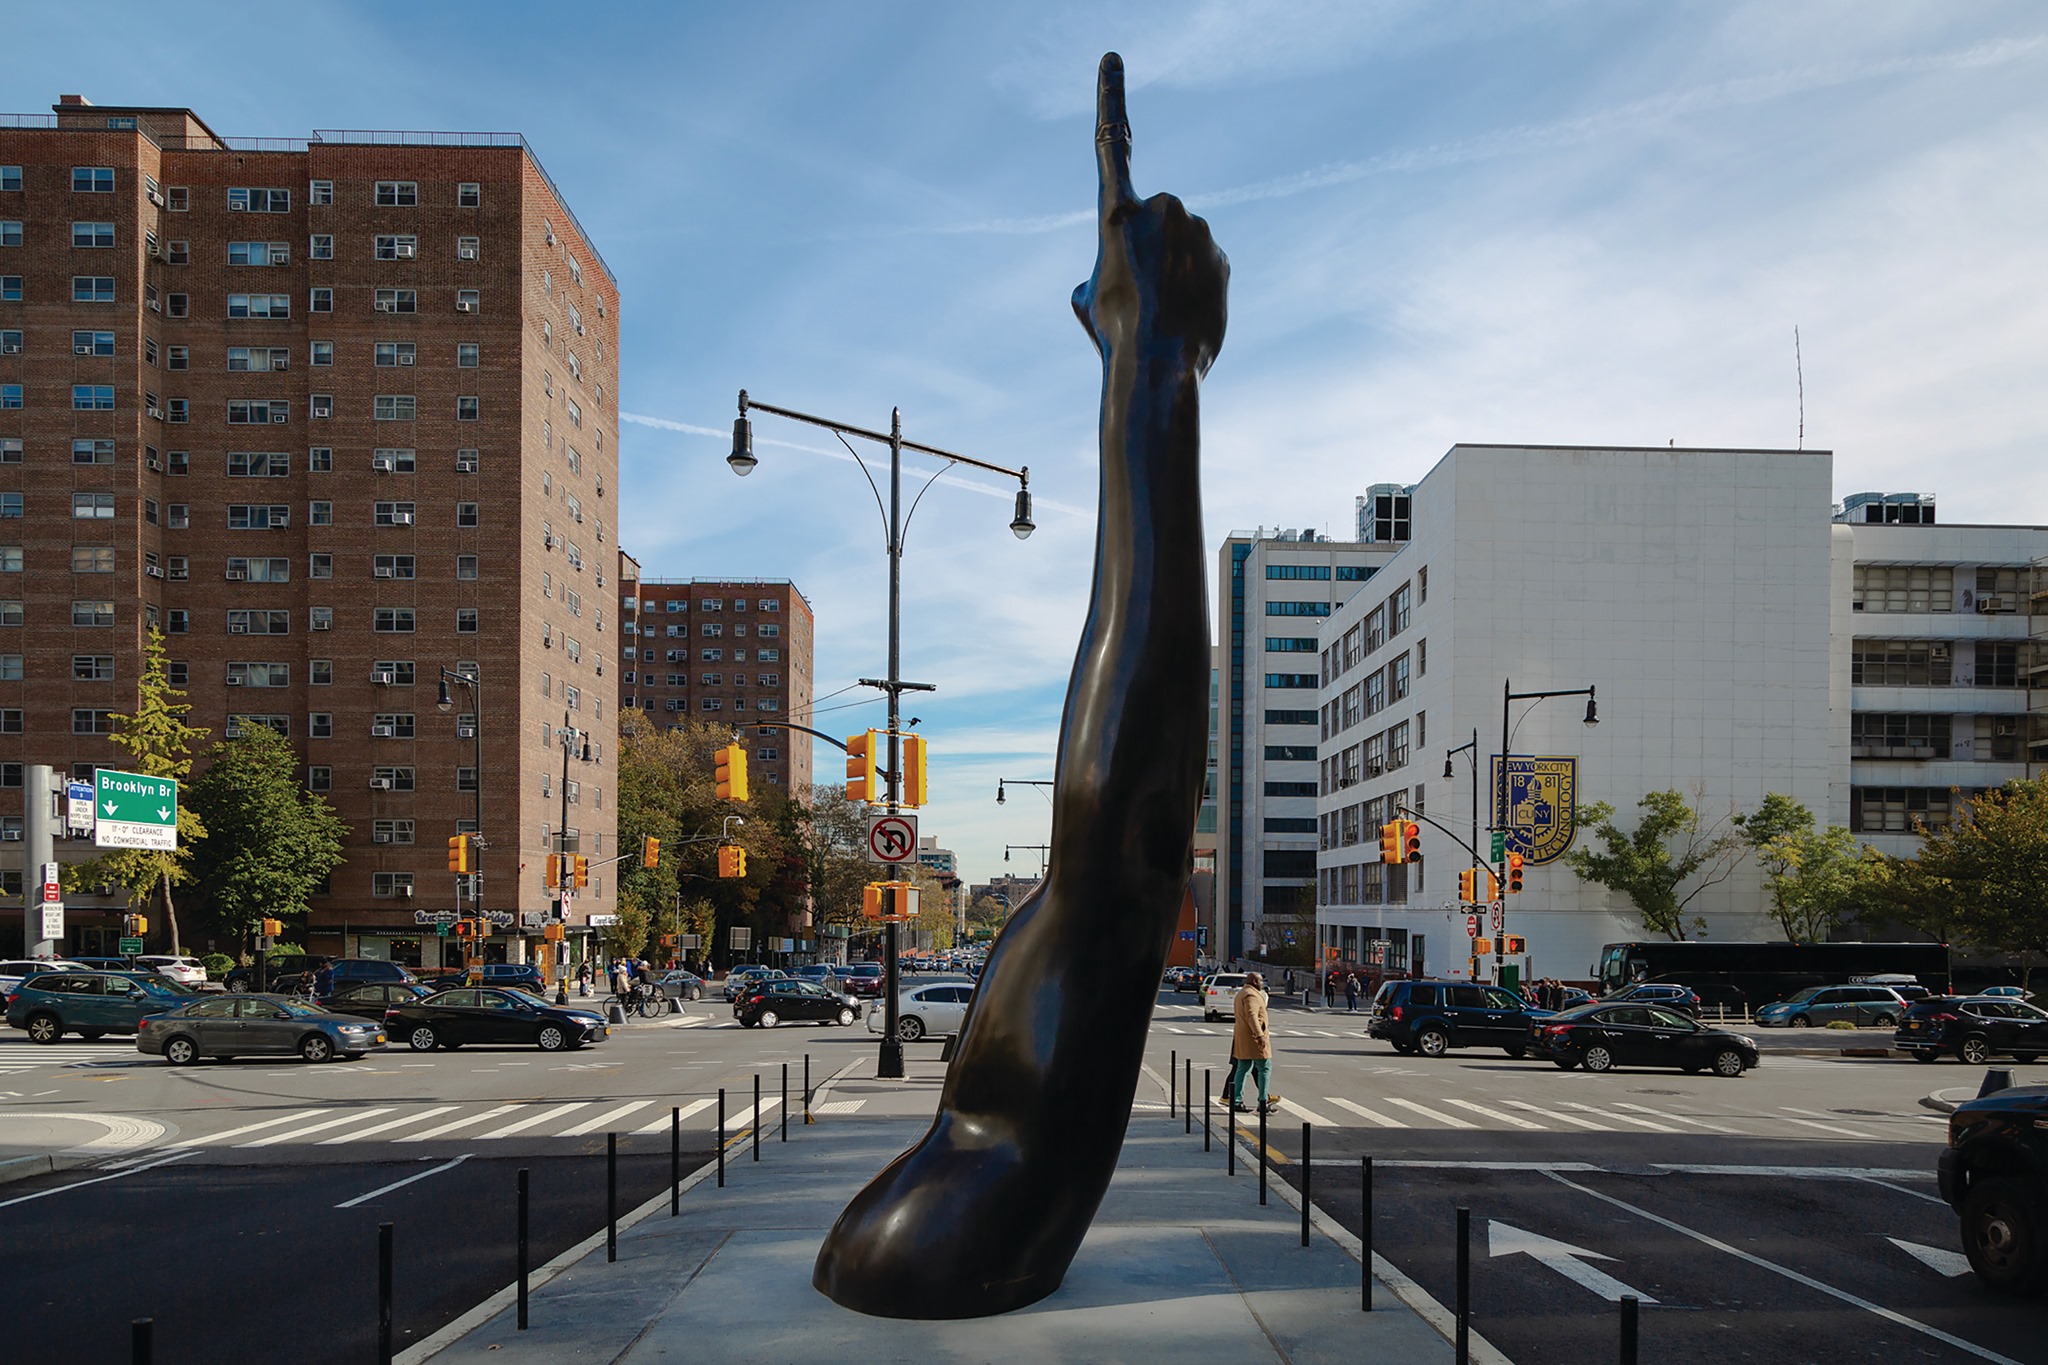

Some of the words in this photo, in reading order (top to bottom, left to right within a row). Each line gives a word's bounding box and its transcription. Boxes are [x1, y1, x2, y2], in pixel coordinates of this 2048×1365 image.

[1525, 762, 1550, 771] YORK
[1550, 763, 1570, 772] CITY
[102, 776, 154, 797] Brooklyn
[159, 784, 171, 797] Br
[1513, 775, 1525, 787] 18
[1544, 776, 1556, 788] 81
[1512, 843, 1533, 858] OF
[1536, 773, 1571, 858] TECHNOLOGY
[1518, 809, 1550, 819] CUNY
[132, 826, 163, 836] CLEARANCE
[102, 835, 110, 844] NO
[113, 835, 148, 846] COMMERCIAL
[151, 838, 172, 847] TRAFFIC
